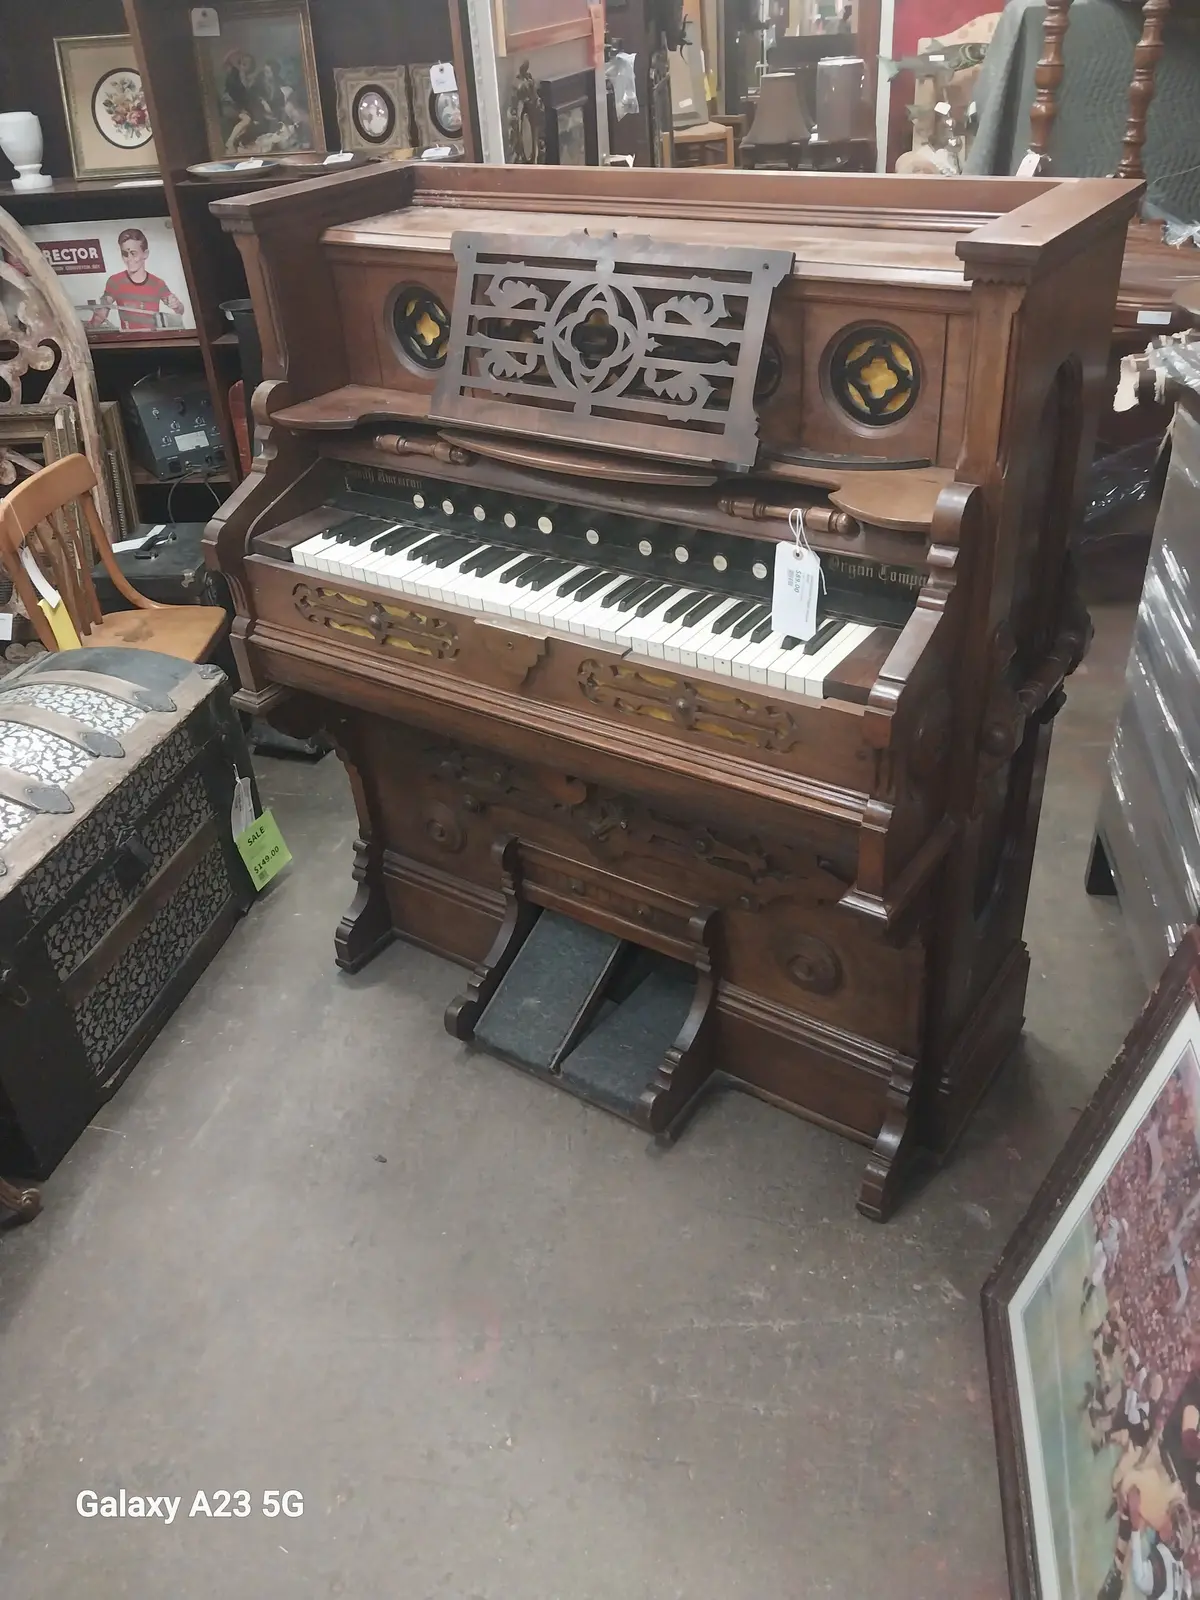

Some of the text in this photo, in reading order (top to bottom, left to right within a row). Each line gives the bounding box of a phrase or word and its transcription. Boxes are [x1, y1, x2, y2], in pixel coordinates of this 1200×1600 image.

[829, 556, 874, 579] Organ
[247, 826, 265, 846] SALE
[254, 845, 280, 874] $149.00
